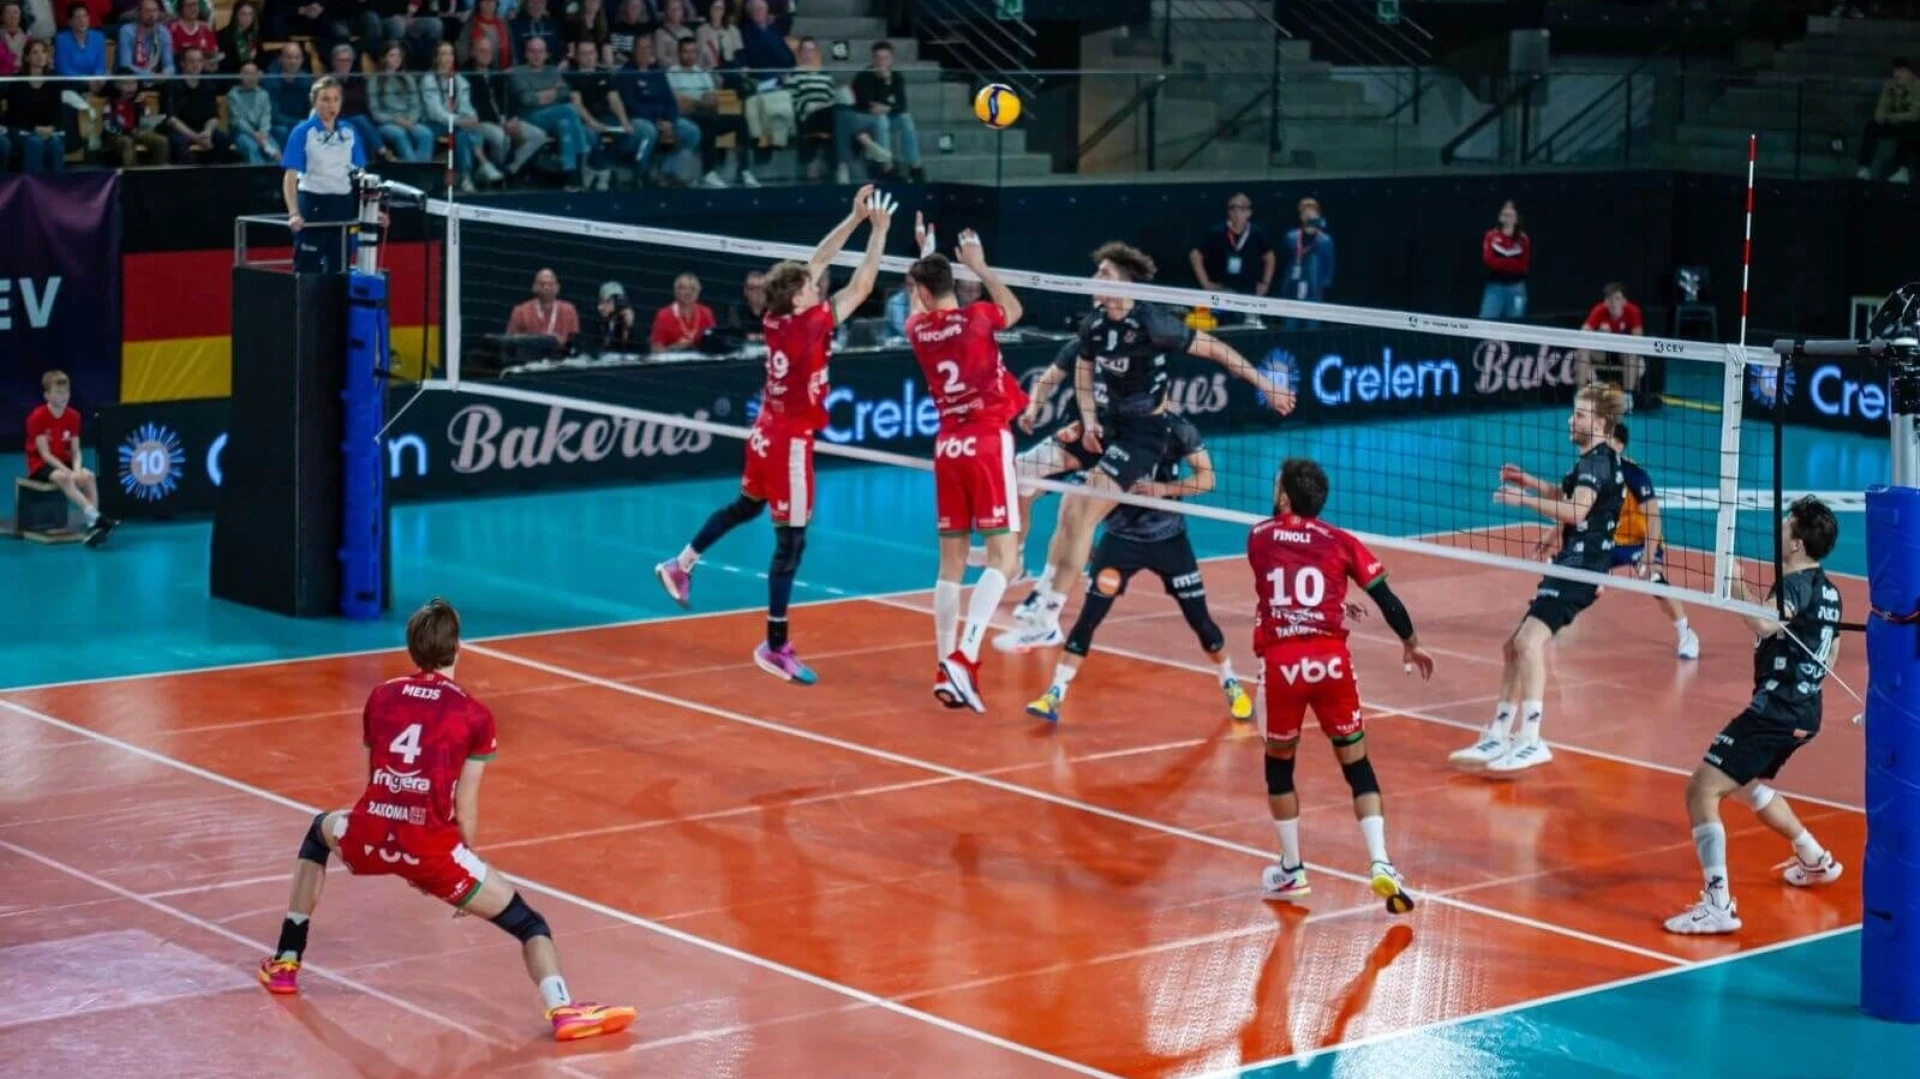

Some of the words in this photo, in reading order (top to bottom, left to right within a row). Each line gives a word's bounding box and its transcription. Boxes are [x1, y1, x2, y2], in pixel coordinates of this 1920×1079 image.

[936, 360, 967, 394] 2
[1311, 347, 1461, 405] Crelem
[823, 378, 941, 444] Crele
[935, 436, 977, 459] vbc
[135, 454, 166, 475] 10
[1273, 529, 1312, 544] FINOLI
[1266, 565, 1326, 608] 10
[1280, 656, 1343, 687] vbc
[401, 684, 442, 701] MEIJS
[388, 723, 423, 764] 4
[372, 768, 431, 794] frigera
